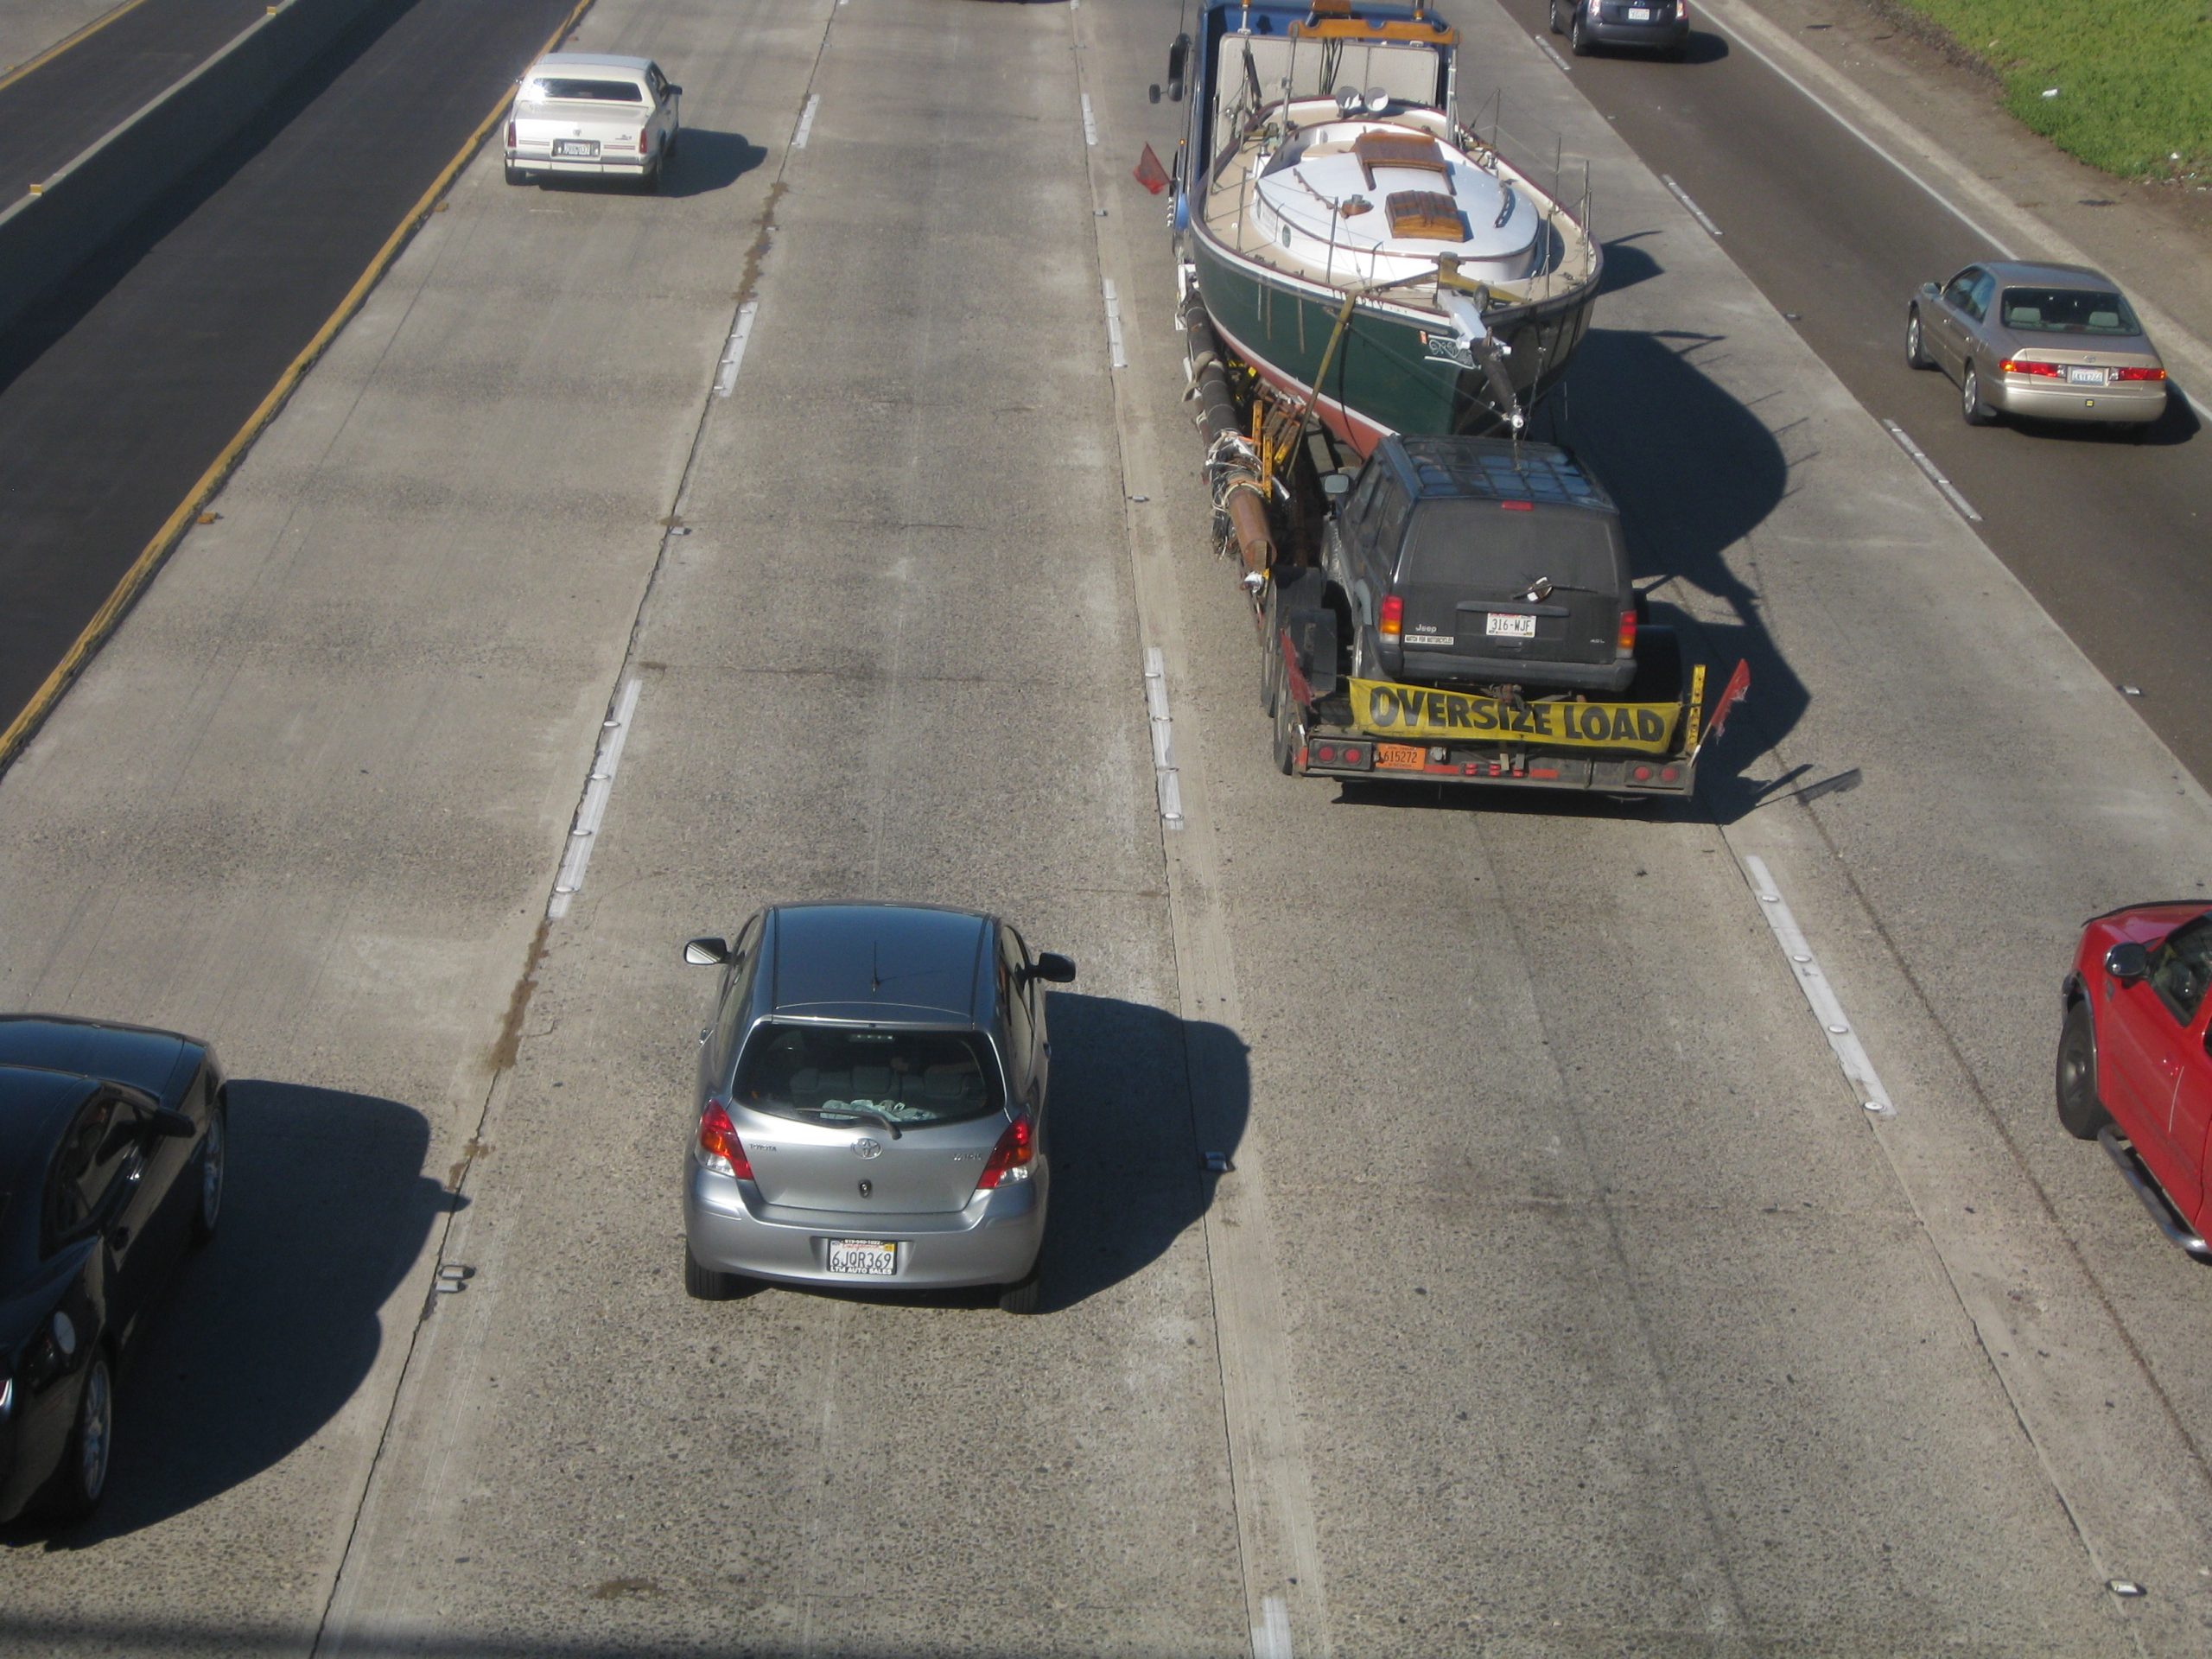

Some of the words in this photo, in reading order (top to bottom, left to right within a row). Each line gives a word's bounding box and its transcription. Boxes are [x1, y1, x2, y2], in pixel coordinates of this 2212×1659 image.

[1415, 624, 1437, 633] Jeep
[1491, 618, 1532, 632] 316-WJF
[1369, 685, 1553, 735] OVERSIZE
[1564, 704, 1665, 743] LOAD
[831, 1250, 892, 1269] 6JQR369
[868, 1267, 892, 1275] SALES
